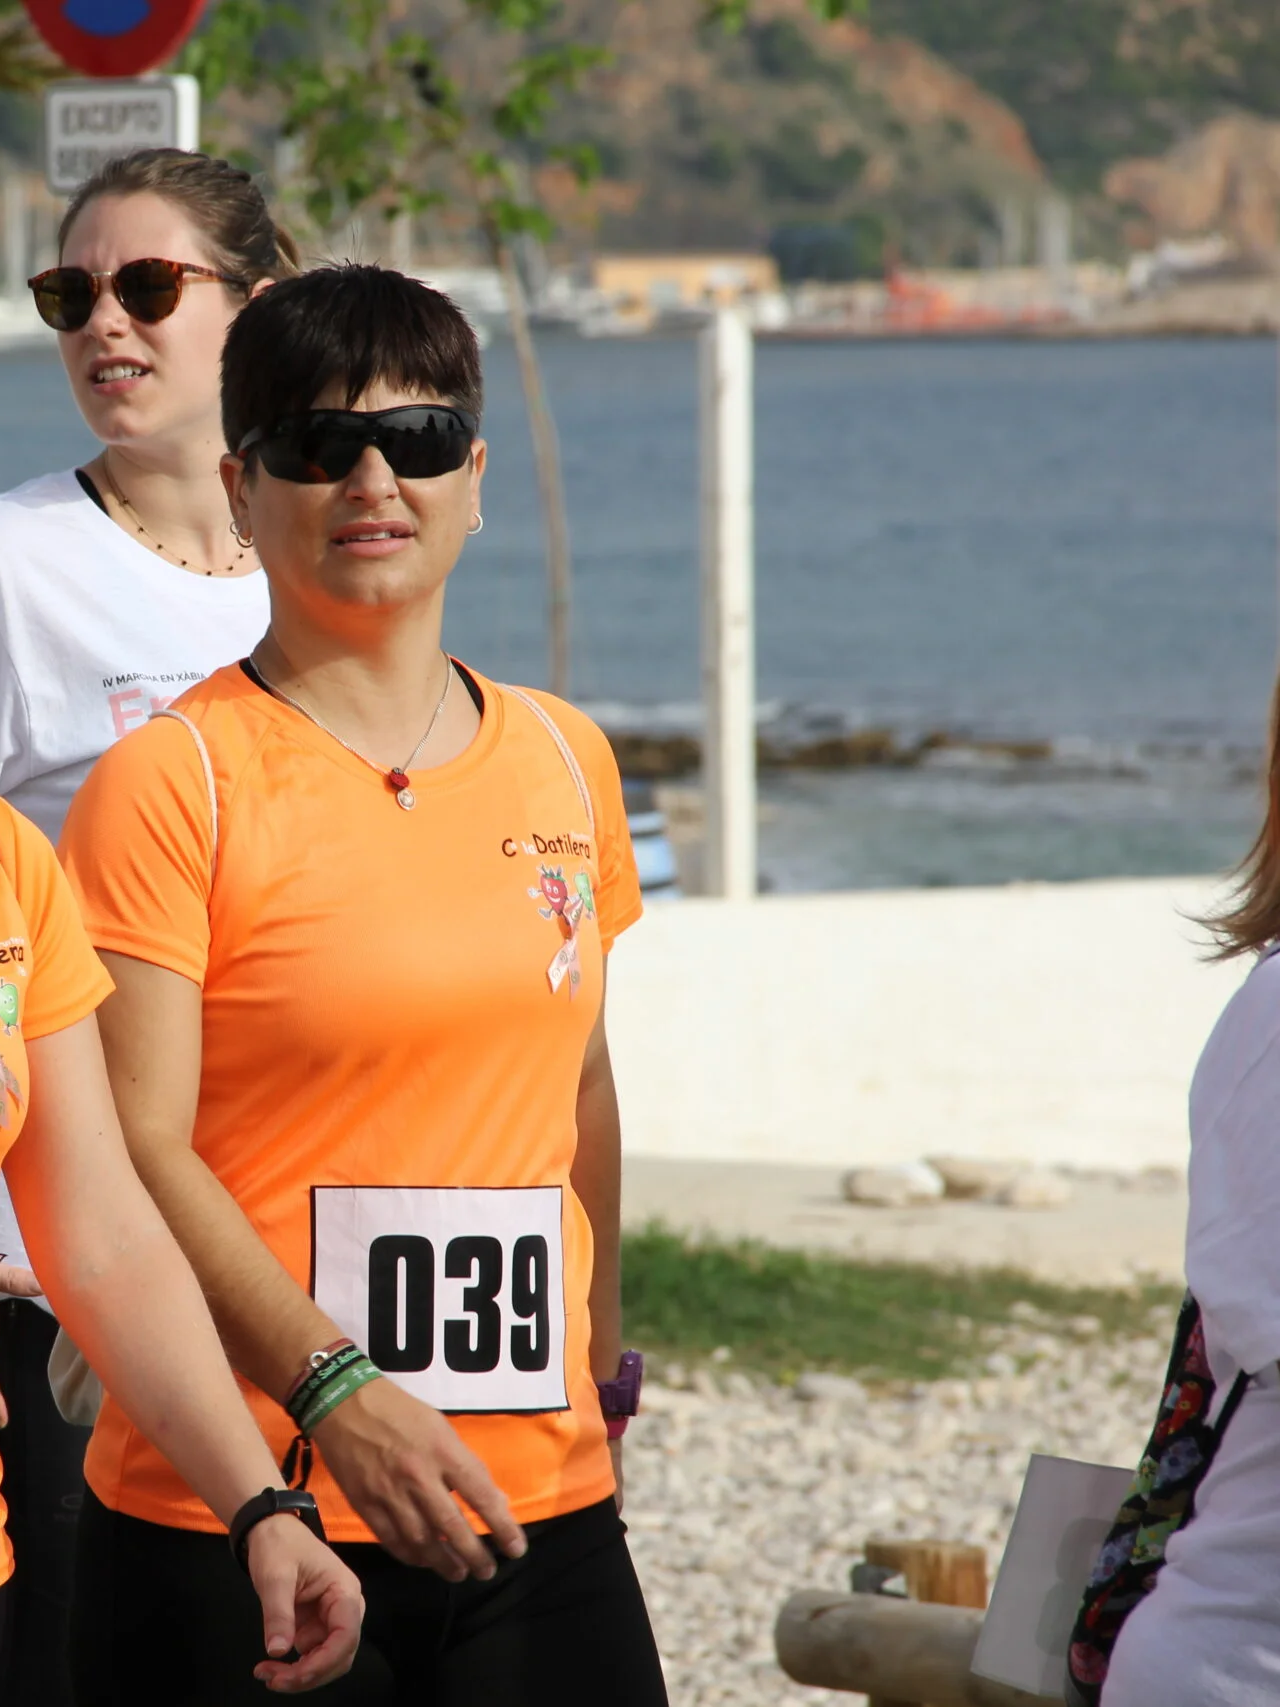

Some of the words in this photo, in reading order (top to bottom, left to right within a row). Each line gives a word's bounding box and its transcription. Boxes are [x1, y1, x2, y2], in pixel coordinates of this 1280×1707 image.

[102, 678, 113, 688] IV
[116, 672, 160, 686] MARCHA
[160, 675, 175, 683] EN
[368, 1234, 550, 1374] 039
